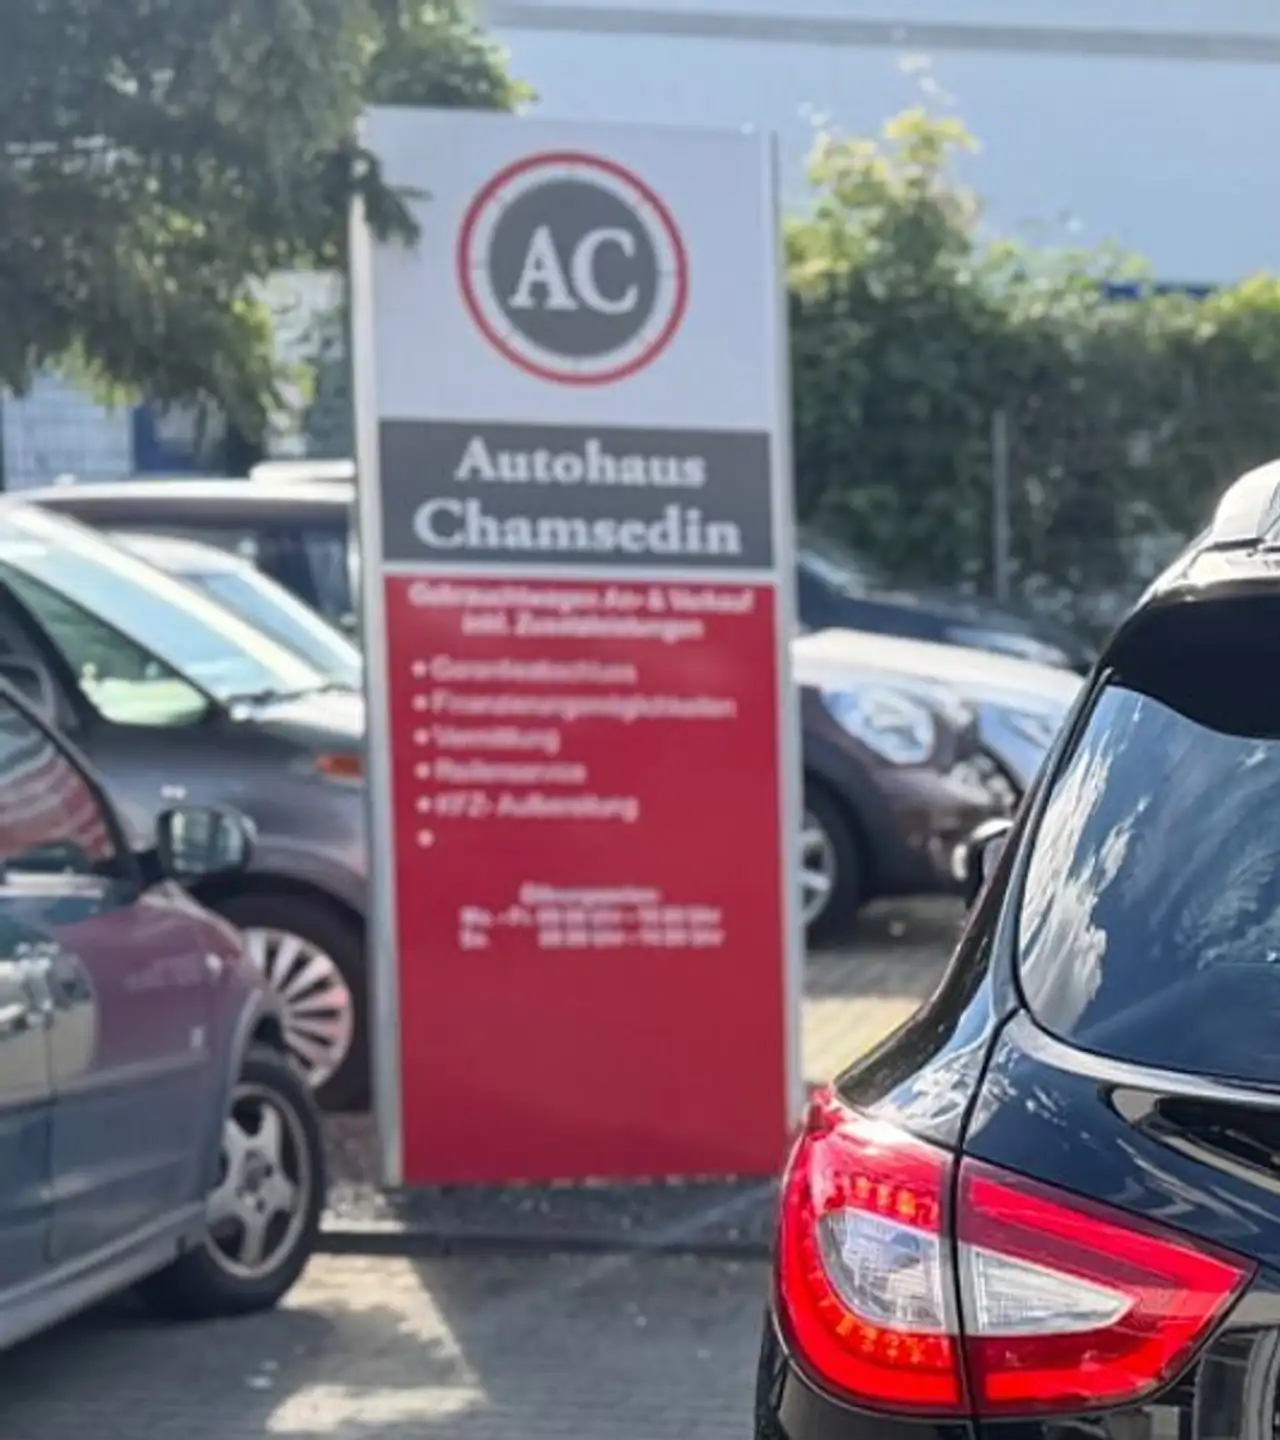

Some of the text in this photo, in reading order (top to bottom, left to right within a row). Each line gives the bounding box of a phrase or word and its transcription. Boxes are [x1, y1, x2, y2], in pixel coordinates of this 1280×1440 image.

[508, 225, 639, 315] AC
[454, 436, 706, 487] Autohaus
[413, 497, 742, 555] Chamsedin
